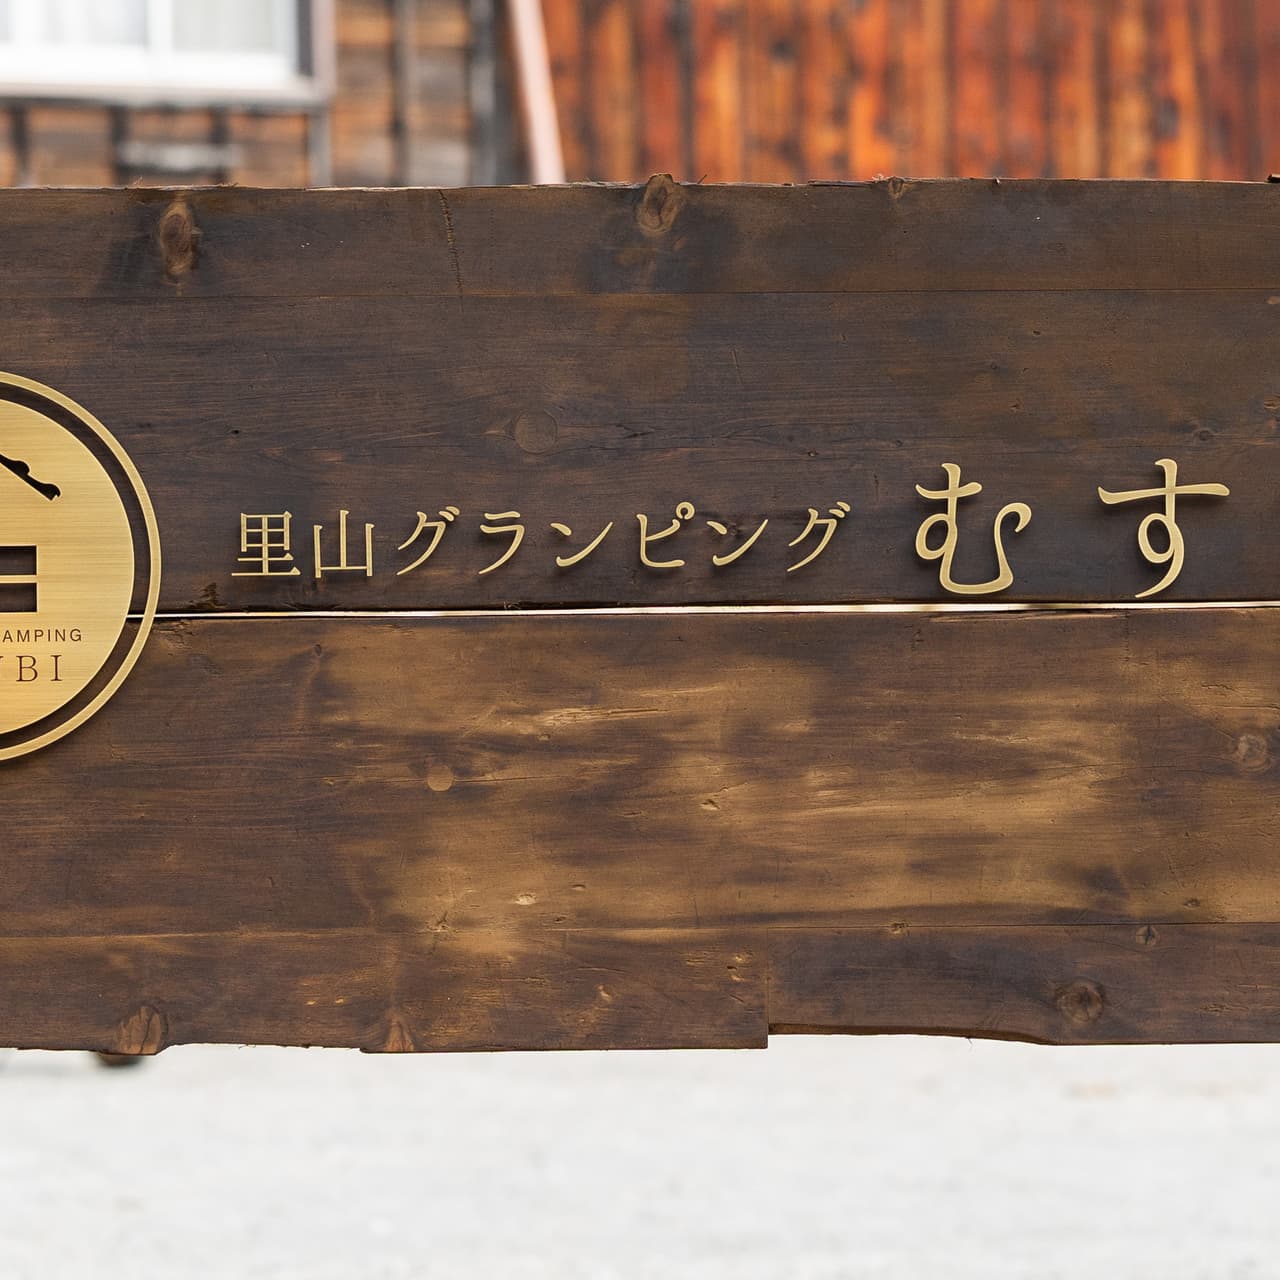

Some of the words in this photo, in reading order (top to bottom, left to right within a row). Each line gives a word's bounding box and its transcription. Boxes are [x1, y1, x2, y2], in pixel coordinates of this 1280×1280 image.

[230, 501, 851, 580] 里山グランピング
